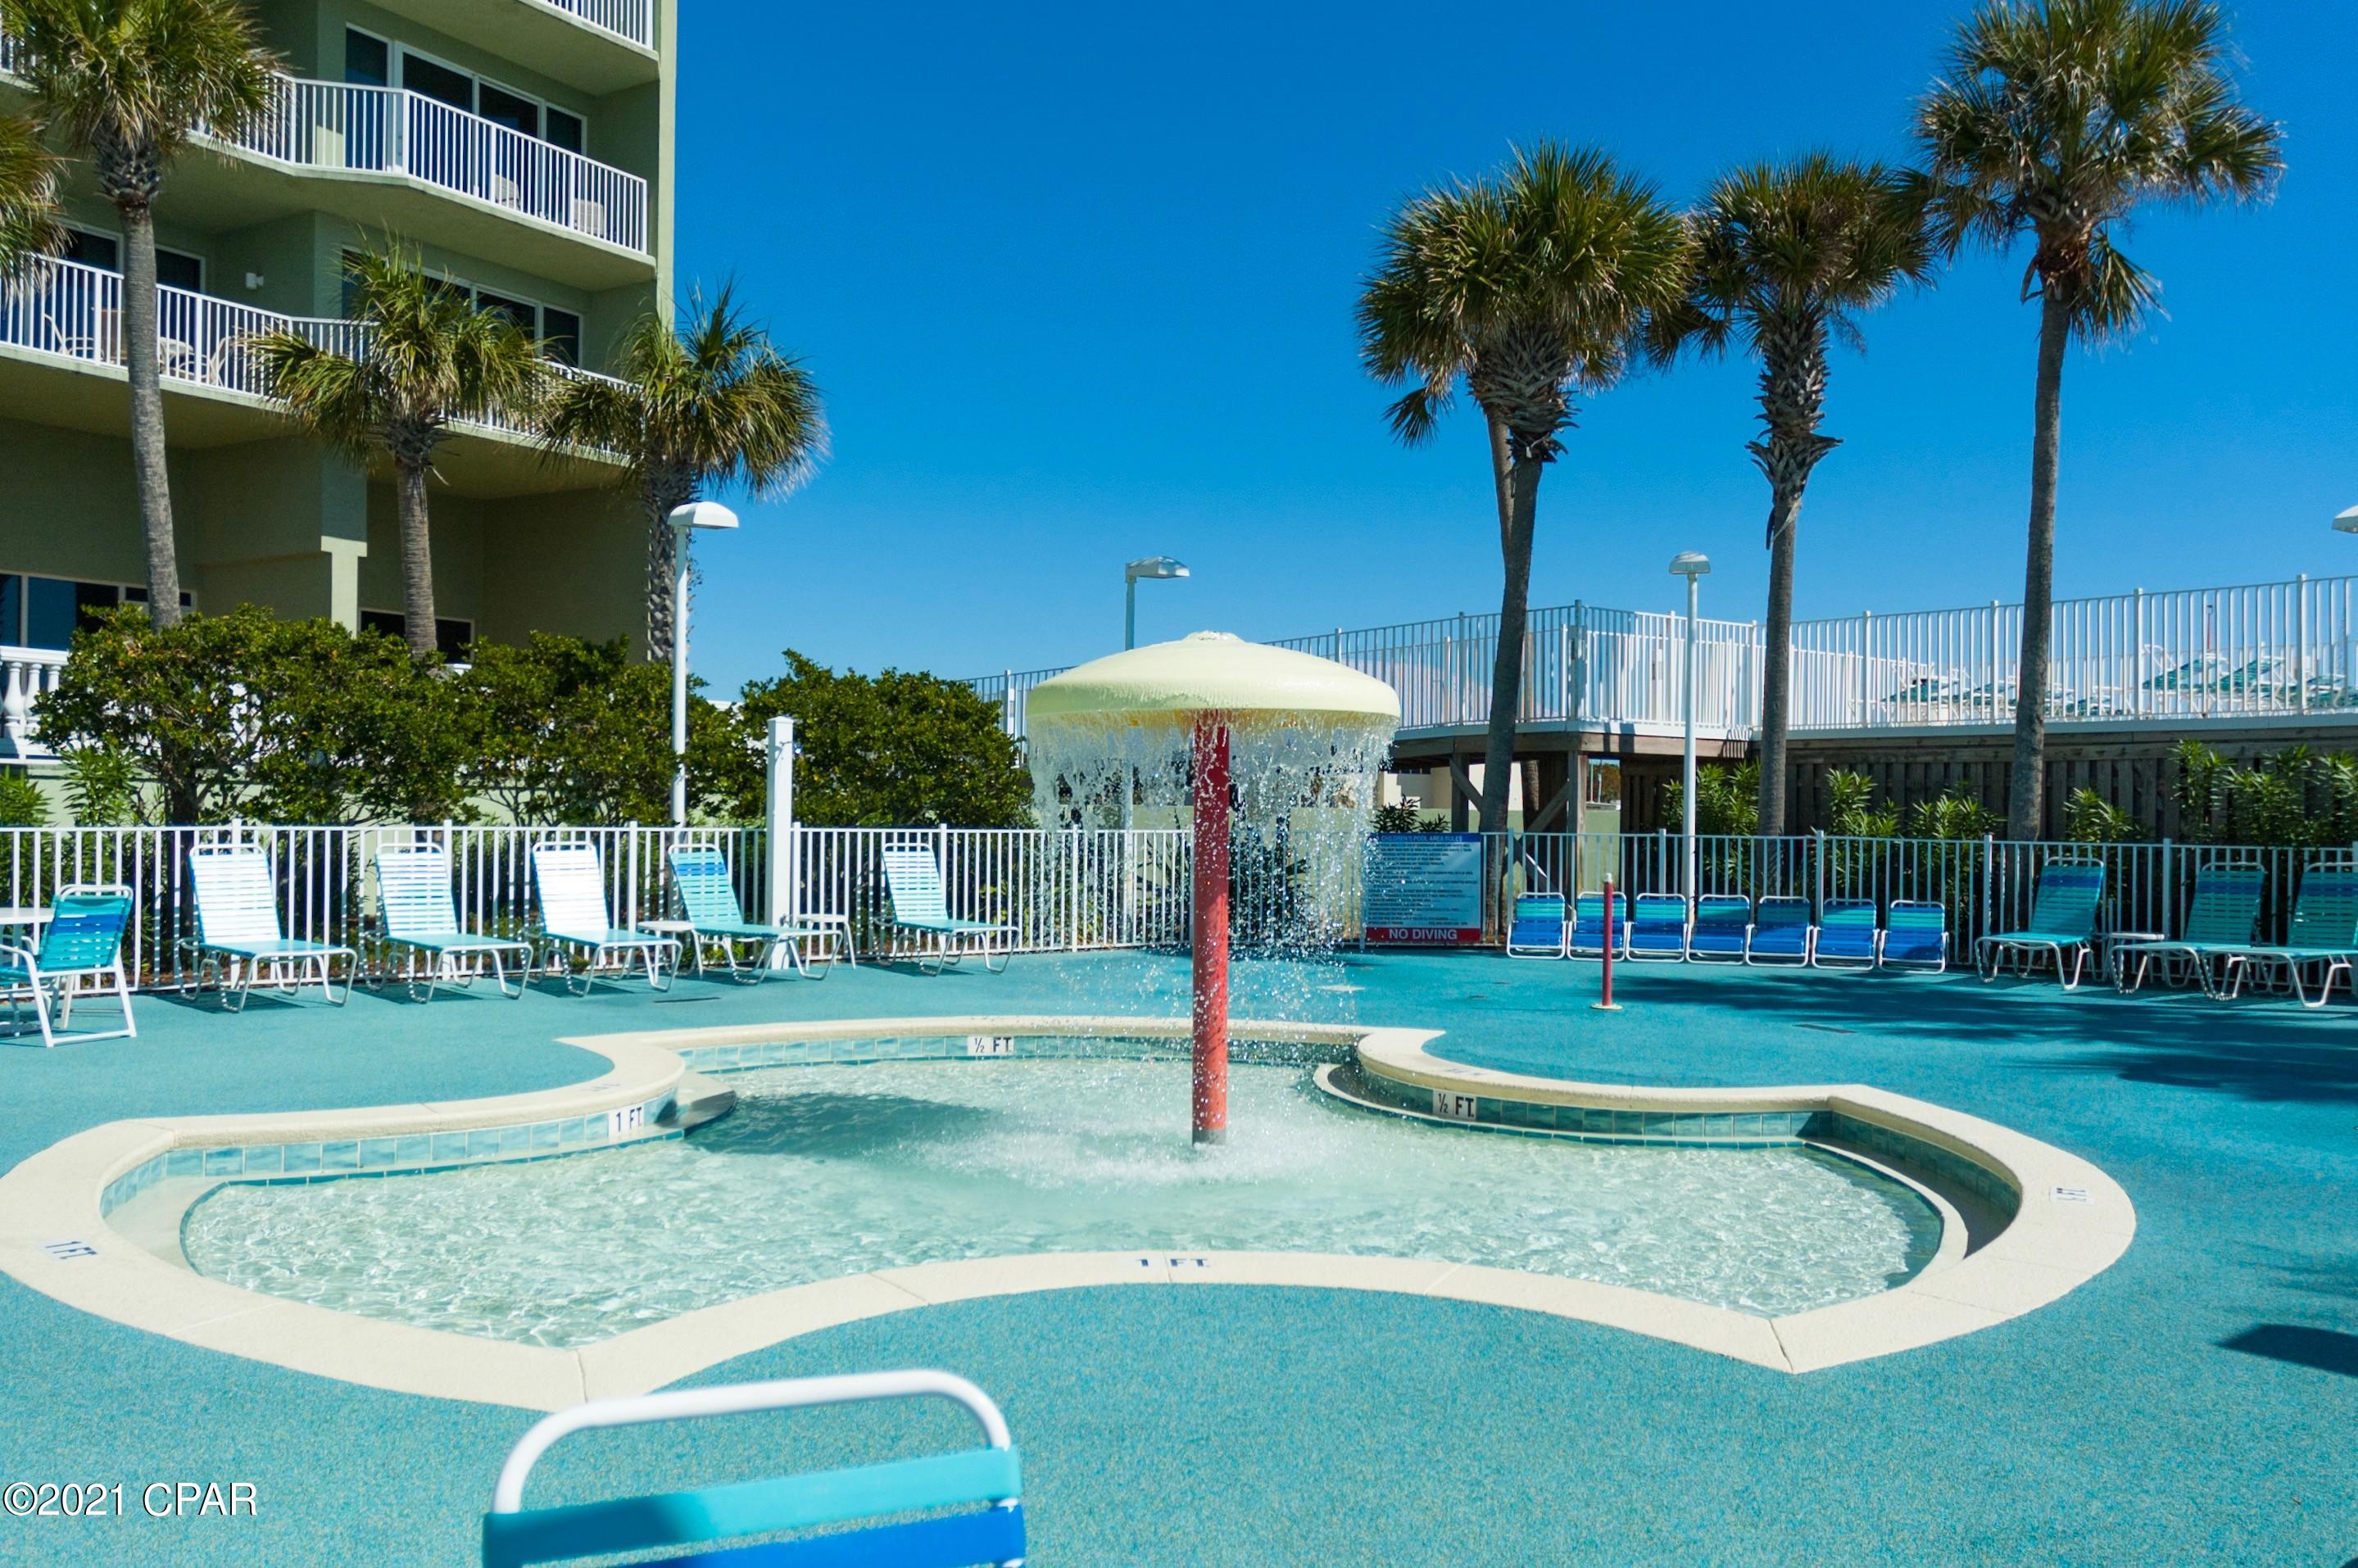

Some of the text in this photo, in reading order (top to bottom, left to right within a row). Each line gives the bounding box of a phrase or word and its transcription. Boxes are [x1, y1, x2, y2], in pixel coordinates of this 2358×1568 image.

[1389, 928, 1458, 940] NO DIVING
[616, 1112, 621, 1132] 1
[1136, 1258, 1149, 1267] 1
